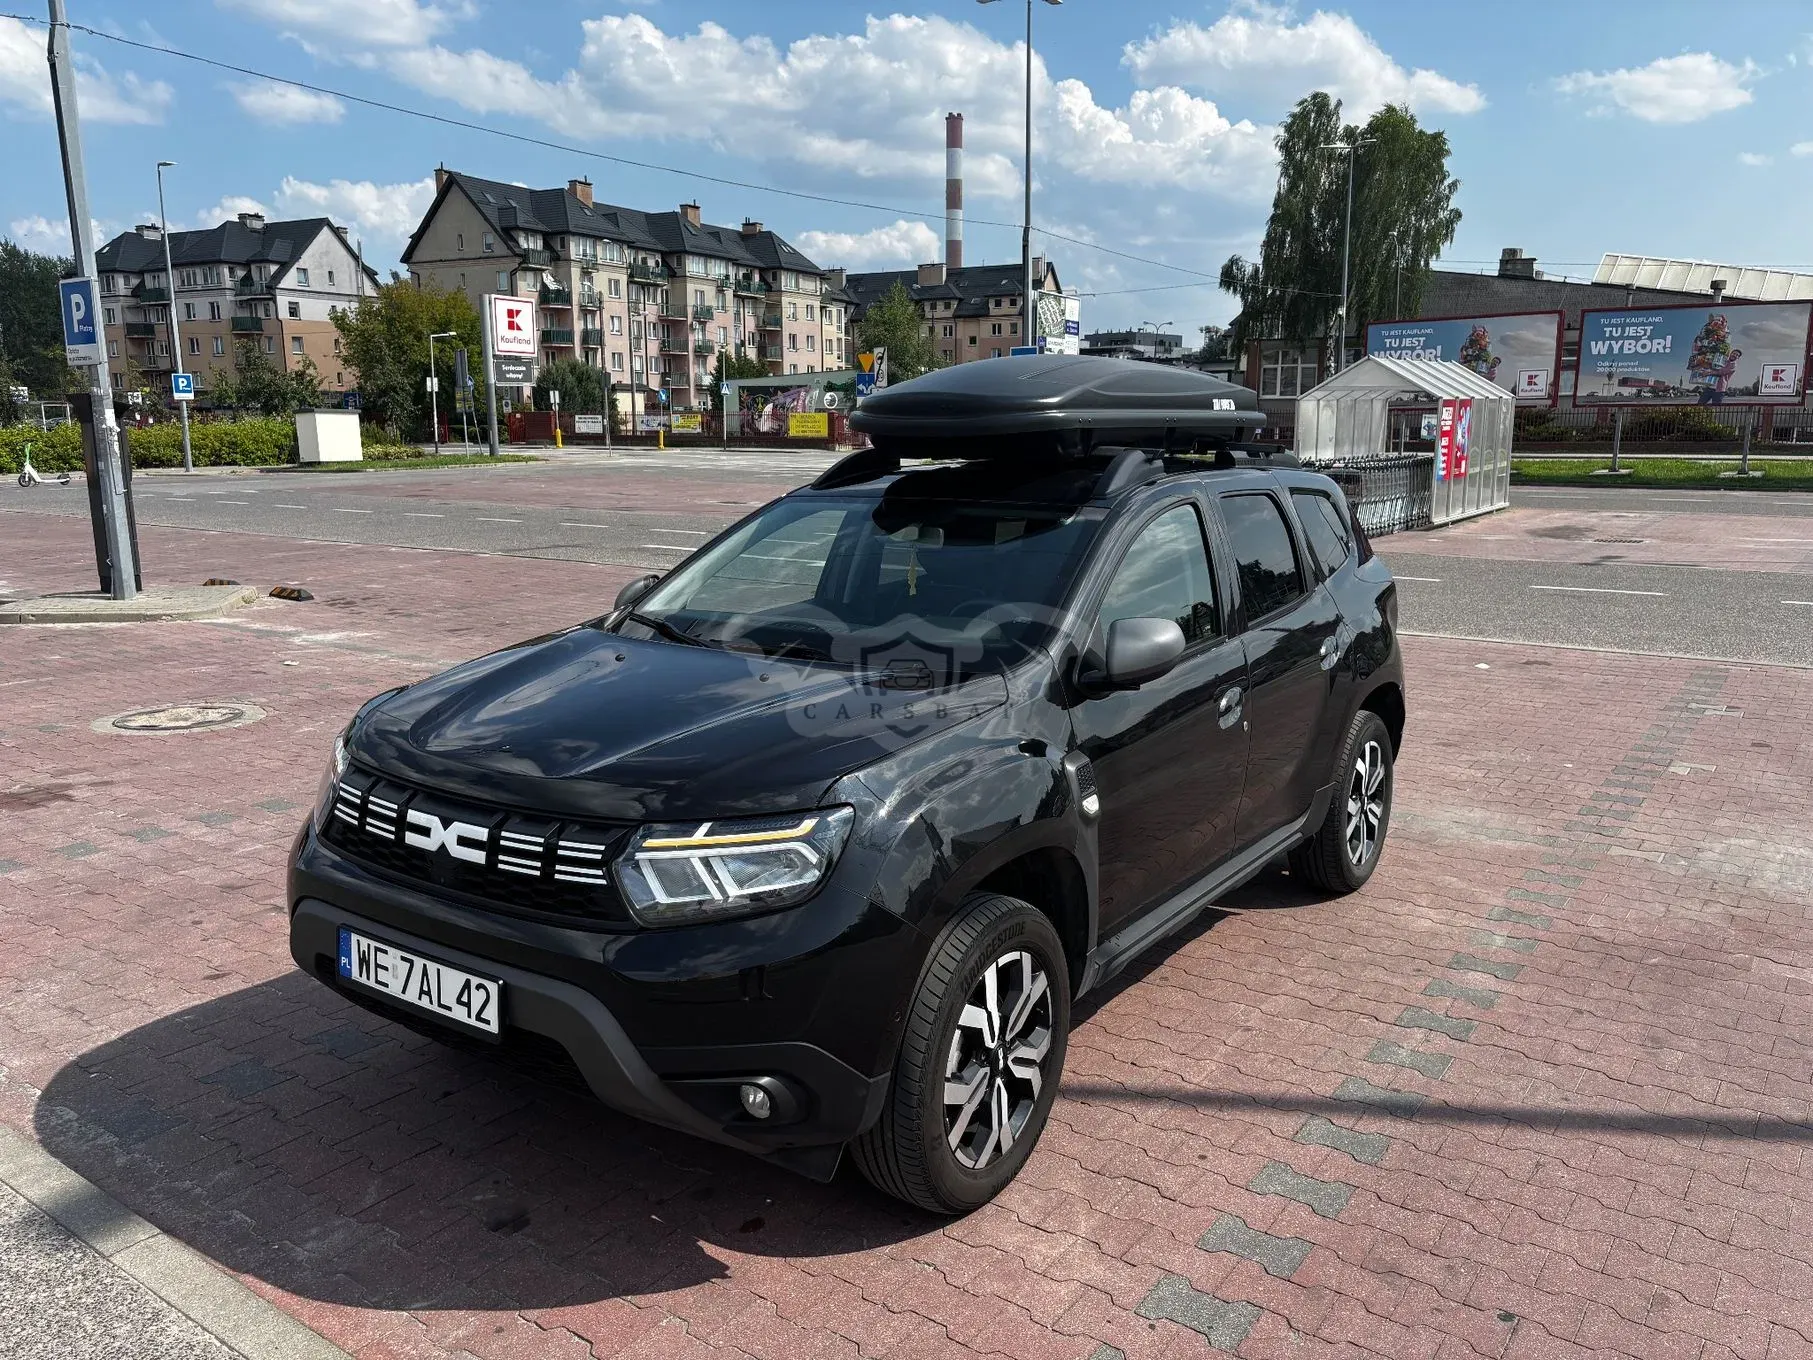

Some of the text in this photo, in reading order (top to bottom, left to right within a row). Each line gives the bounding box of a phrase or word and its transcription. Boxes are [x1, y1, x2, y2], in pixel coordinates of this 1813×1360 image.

[70, 293, 86, 333] P
[1604, 326, 1654, 337] TU JEST
[500, 335, 531, 345] Kaufland
[1384, 337, 1426, 348] TU JEST
[1590, 335, 1672, 355] WYBÓR!
[178, 377, 188, 391] P
[341, 956, 351, 969] PL
[356, 938, 492, 1026] WE 7AL42
